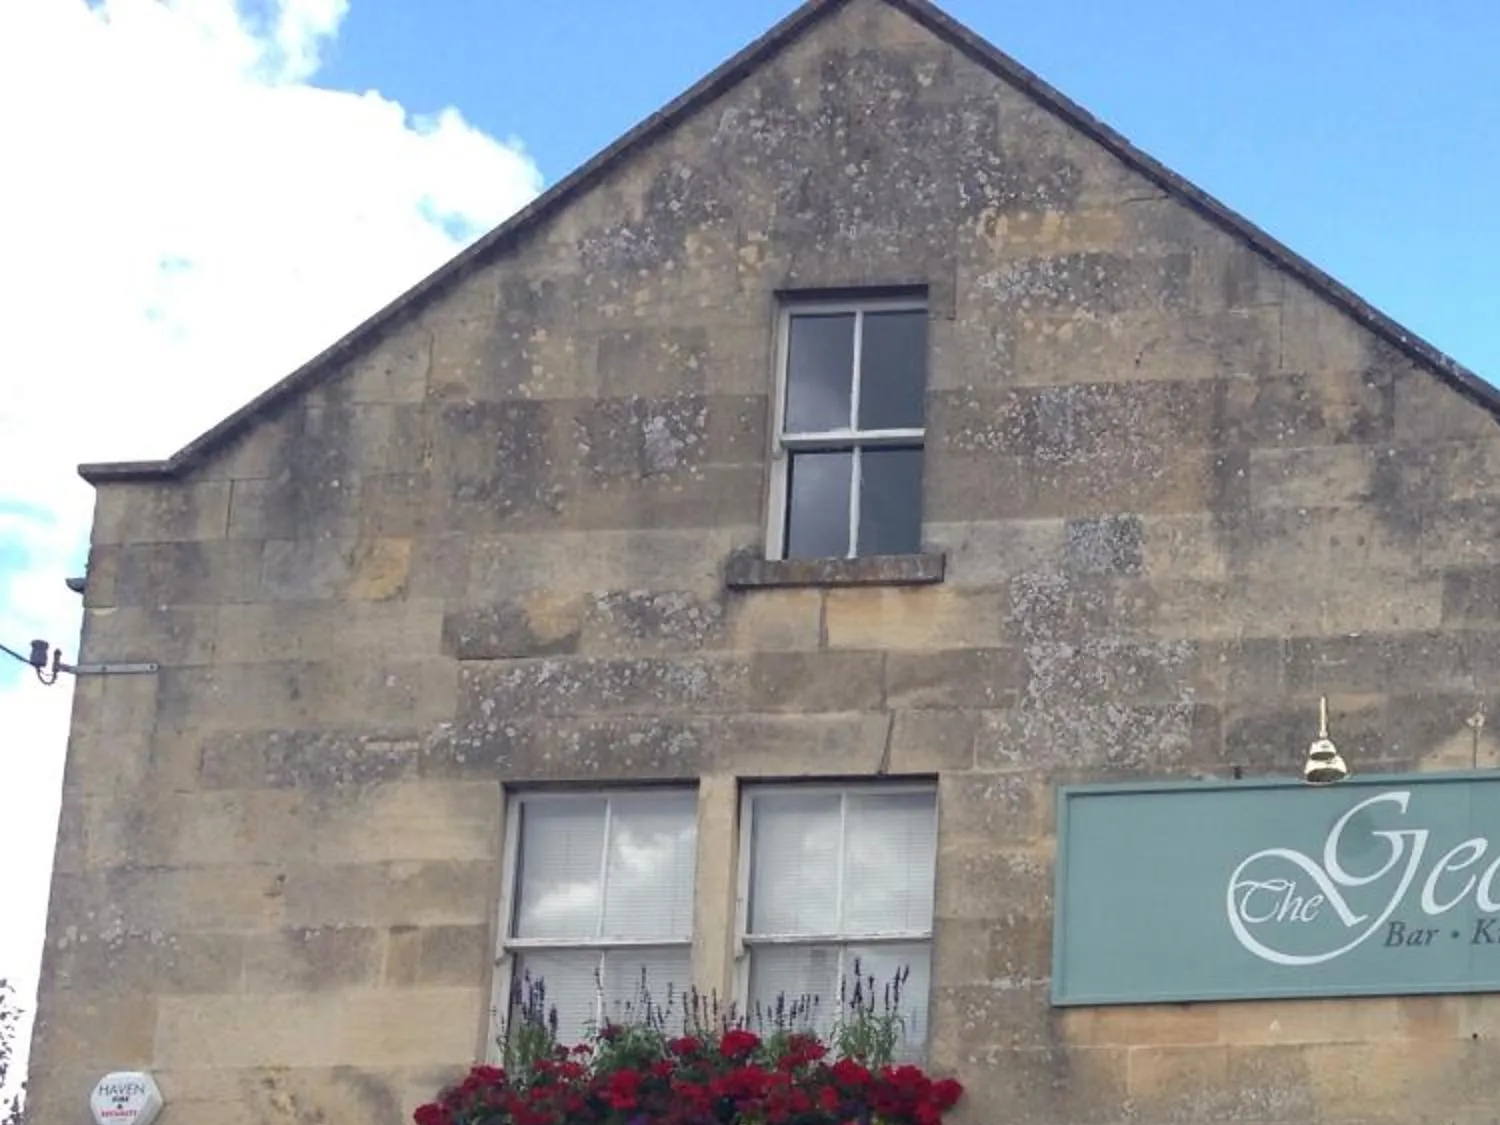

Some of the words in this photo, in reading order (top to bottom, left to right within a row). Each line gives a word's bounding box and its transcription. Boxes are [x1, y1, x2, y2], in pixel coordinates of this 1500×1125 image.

[1234, 879, 1325, 923] The
[1385, 921, 1440, 947] Bar
[99, 1083, 146, 1097] HAVEN
